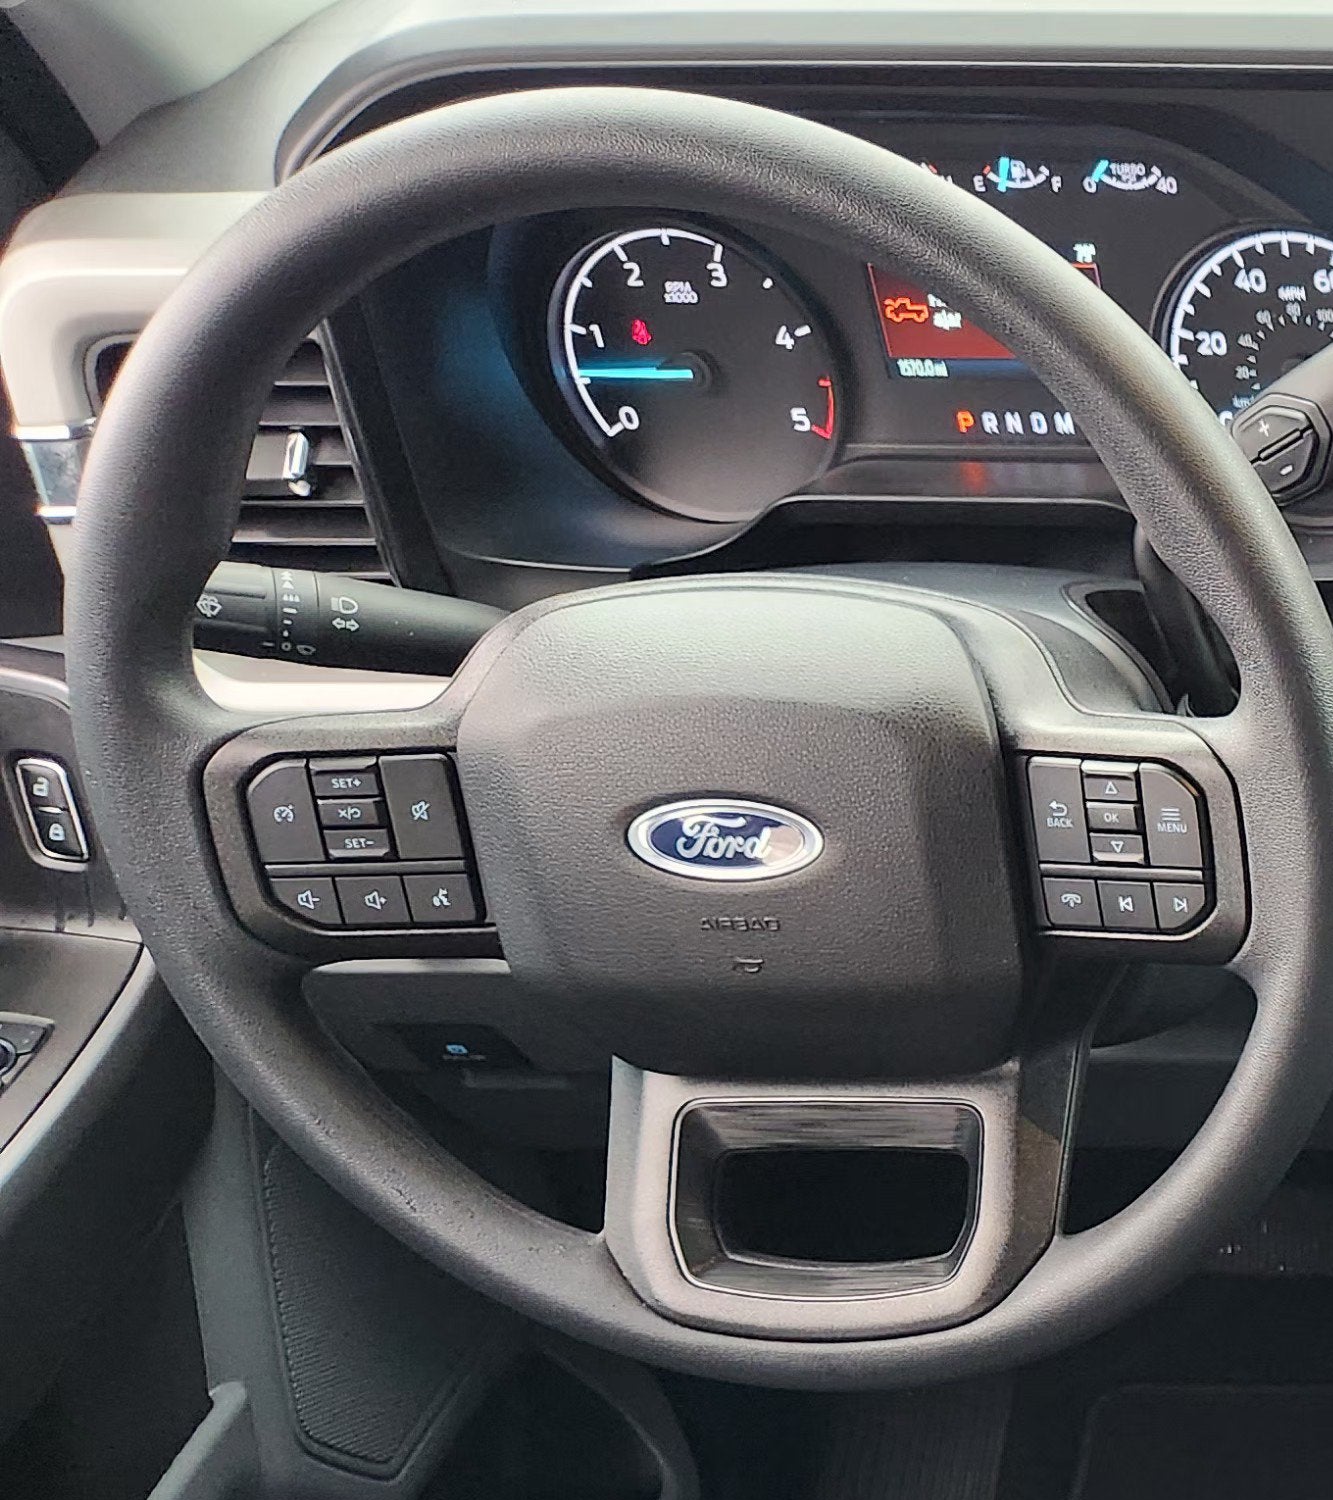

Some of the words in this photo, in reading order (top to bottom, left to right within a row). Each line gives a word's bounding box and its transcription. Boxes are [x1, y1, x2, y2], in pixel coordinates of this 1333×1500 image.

[623, 262, 644, 286] 2
[706, 262, 728, 287] 3
[1234, 268, 1267, 293] 40
[589, 325, 605, 348] 1
[775, 326, 795, 349] 4
[1195, 331, 1227, 356] 20
[618, 406, 639, 430] 0
[790, 408, 811, 432] 5
[956, 411, 974, 433] P
[981, 412, 1000, 435] R
[1004, 412, 1024, 435] N
[1028, 412, 1048, 434] D
[1053, 412, 1075, 436] M
[1046, 817, 1074, 828] BACK
[1103, 812, 1119, 823] OK
[1156, 822, 1187, 833] MENU
[676, 815, 771, 860] Ford
[700, 916, 780, 932] AIRBAG
